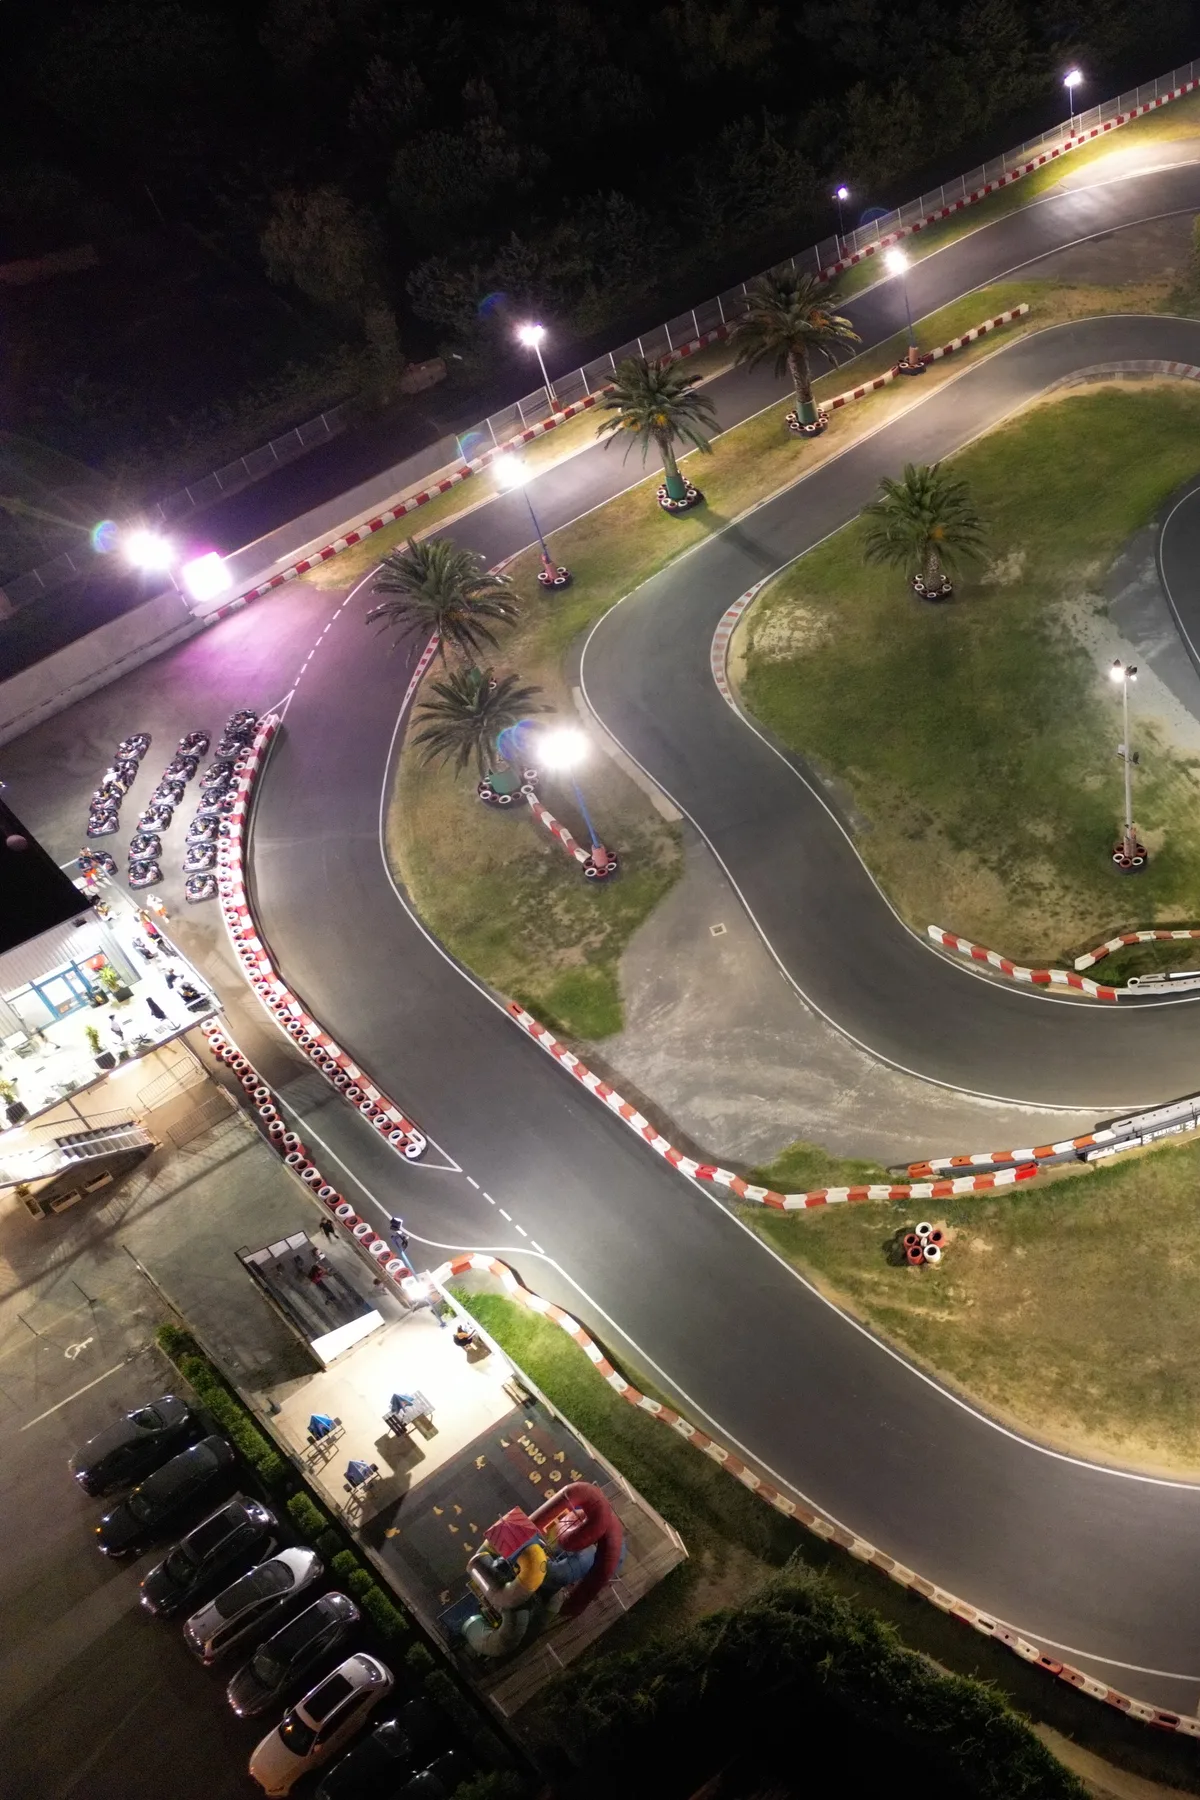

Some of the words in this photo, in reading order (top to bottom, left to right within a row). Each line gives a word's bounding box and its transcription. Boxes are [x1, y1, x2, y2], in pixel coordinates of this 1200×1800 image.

[525, 1443, 539, 1456] 2
[533, 1452, 546, 1465] 3
[553, 1451, 565, 1463] 4
[529, 1470, 542, 1484] 5
[549, 1470, 562, 1482] 6
